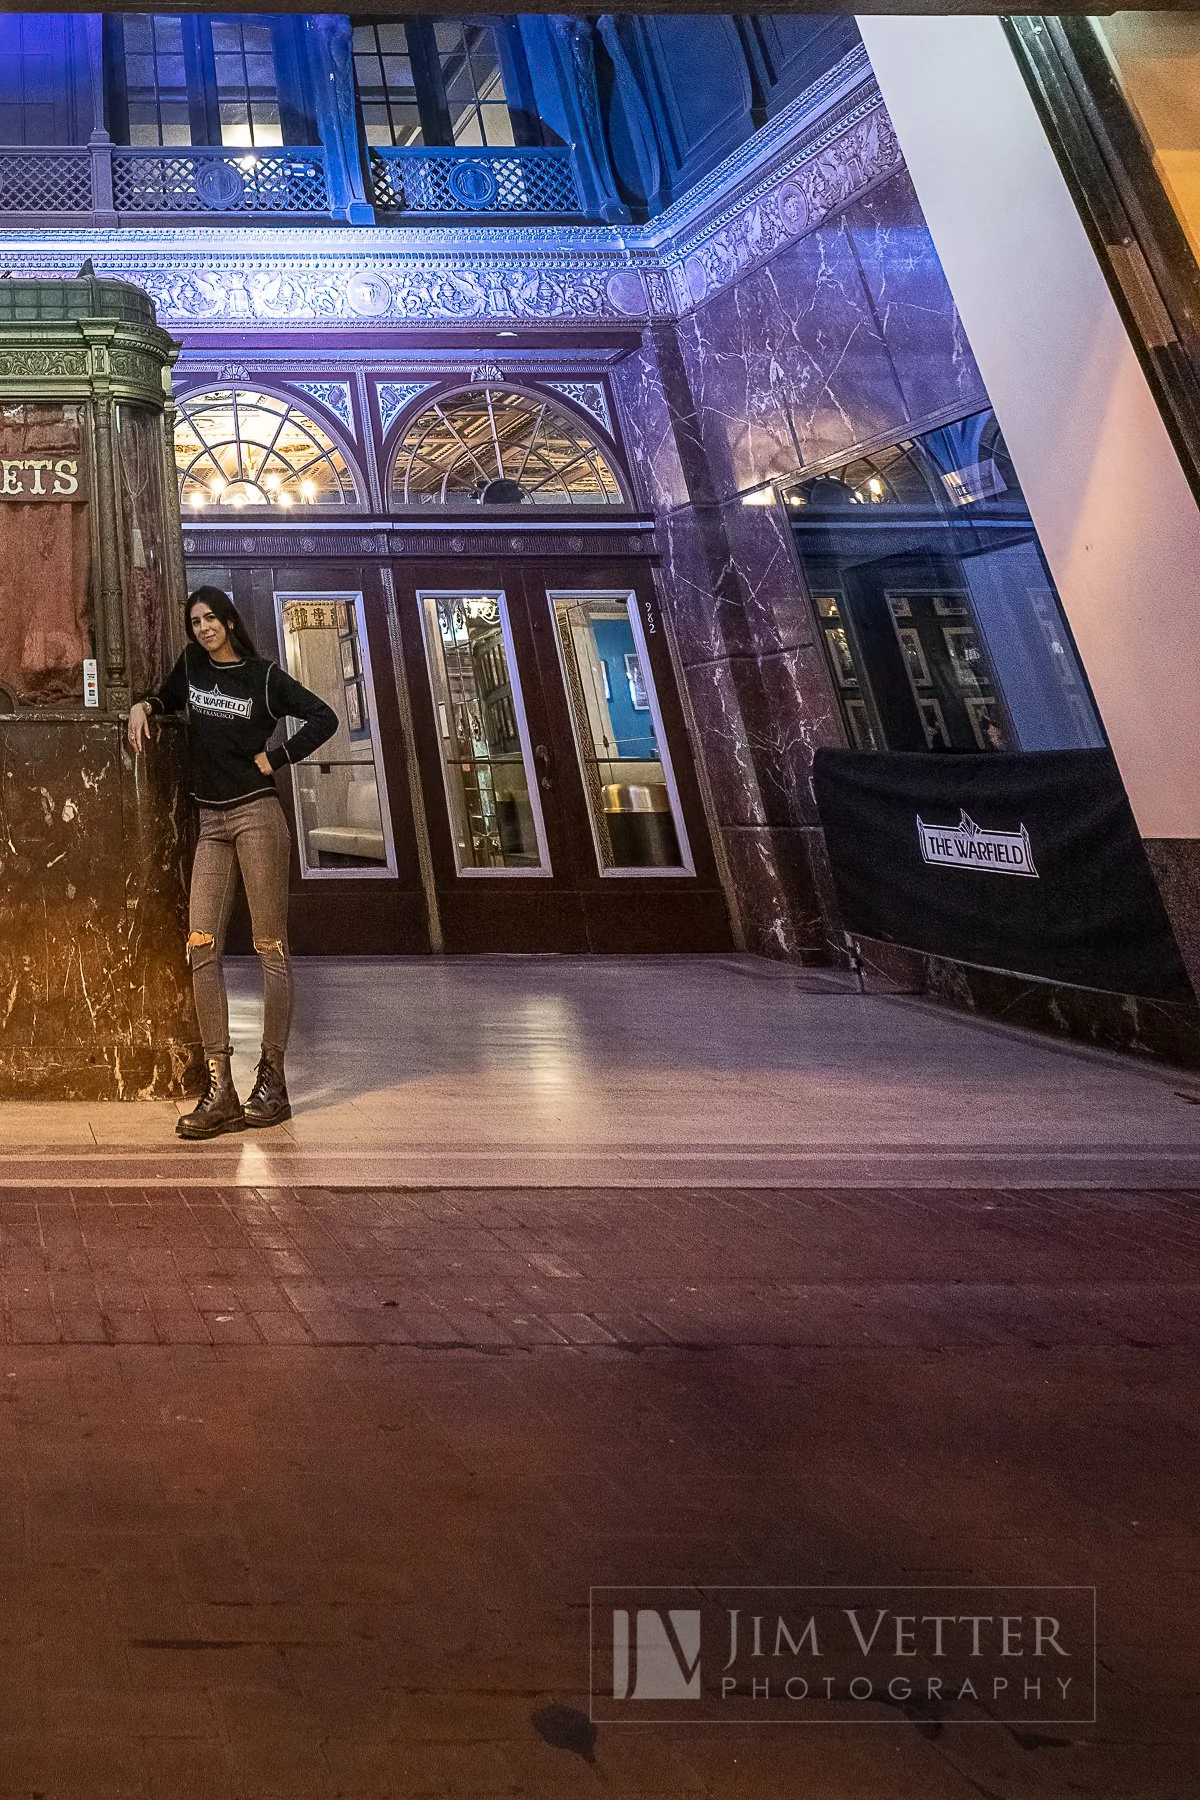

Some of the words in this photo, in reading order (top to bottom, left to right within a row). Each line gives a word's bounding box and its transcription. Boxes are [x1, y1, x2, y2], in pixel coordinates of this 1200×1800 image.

[645, 602, 657, 634] 982
[190, 690, 202, 704] THE
[203, 694, 246, 712] WARFIELD
[928, 836, 954, 856] THE
[953, 839, 1024, 865] WARFIELD
